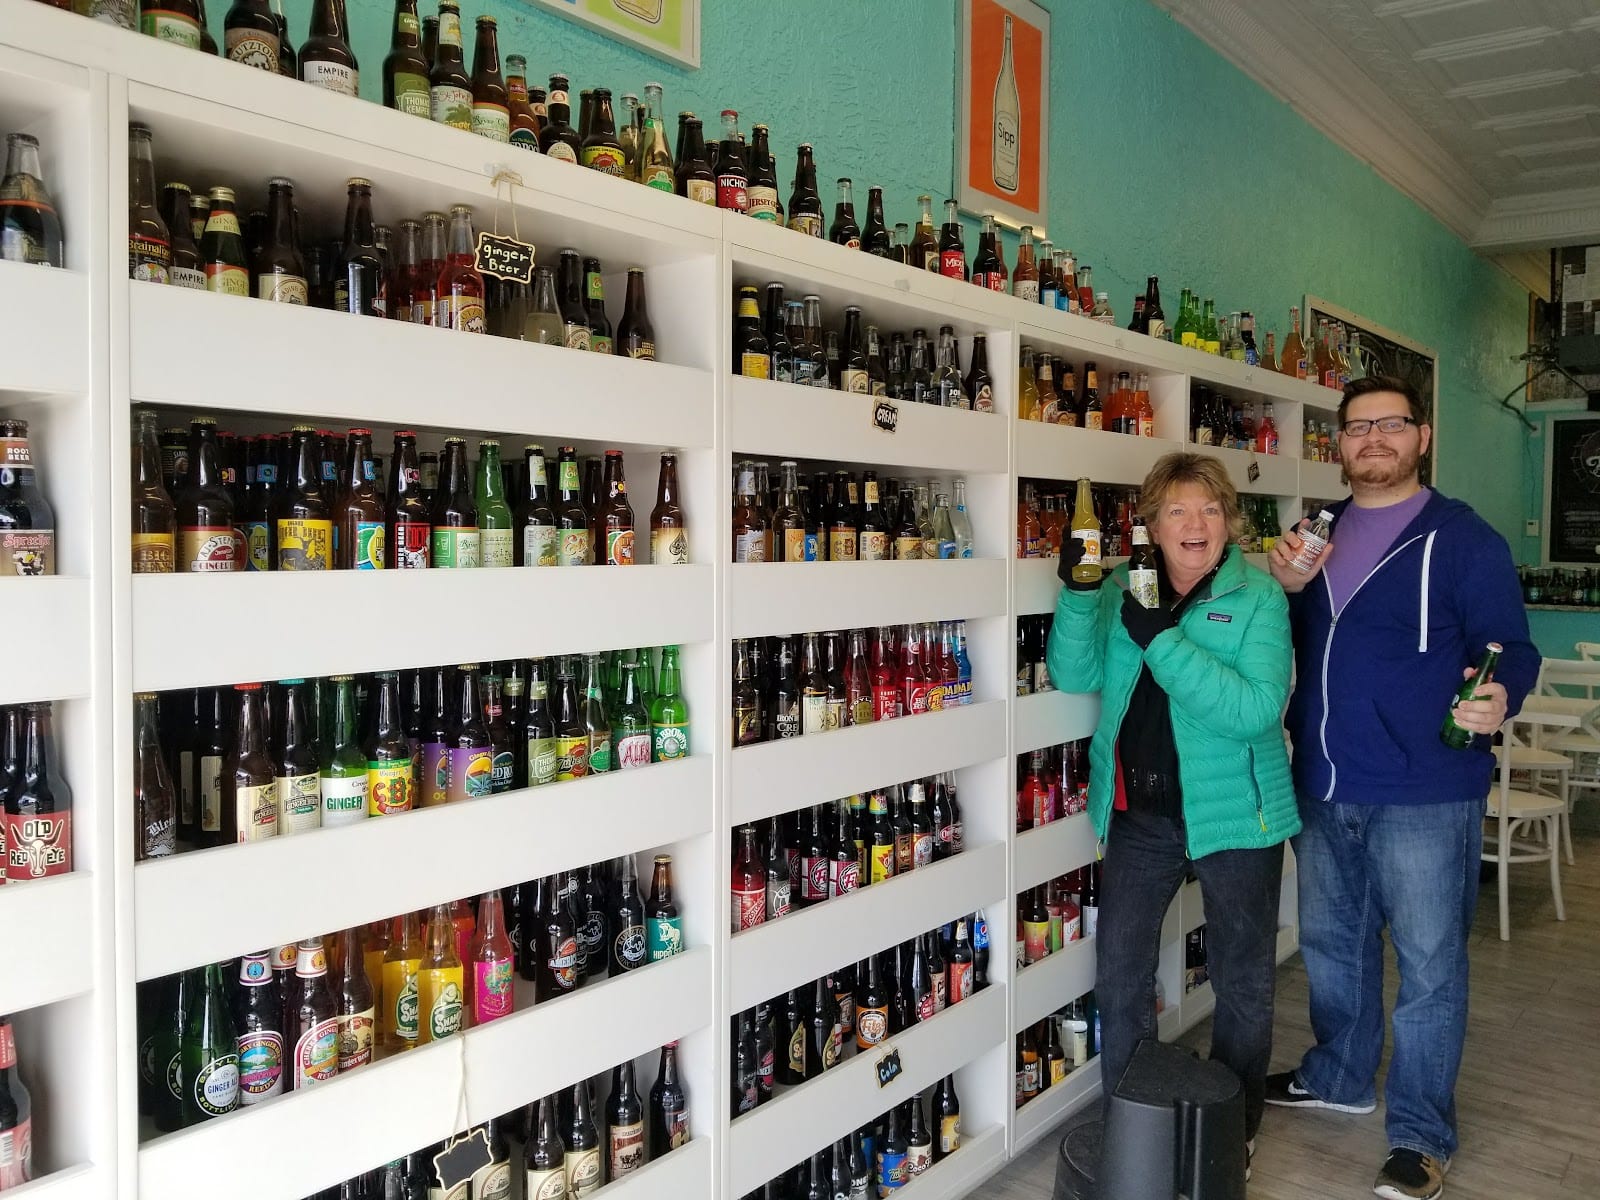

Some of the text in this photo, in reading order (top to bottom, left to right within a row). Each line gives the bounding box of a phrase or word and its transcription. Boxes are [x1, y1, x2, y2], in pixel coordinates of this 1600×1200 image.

[317, 65, 349, 80] EMPIRE
[997, 121, 1015, 149] Sipp
[483, 244, 530, 263] ginger
[488, 259, 520, 275] Beer
[173, 271, 205, 286] EMPIRE
[6, 447, 30, 455] ROOT
[776, 722, 799, 732] CRE
[327, 796, 363, 810] GINGER
[24, 820, 52, 838] OLD
[146, 816, 176, 837] Blen
[10, 848, 65, 866] RED EYE
[880, 1063, 898, 1082] Cola
[207, 1082, 230, 1094] GINGER
